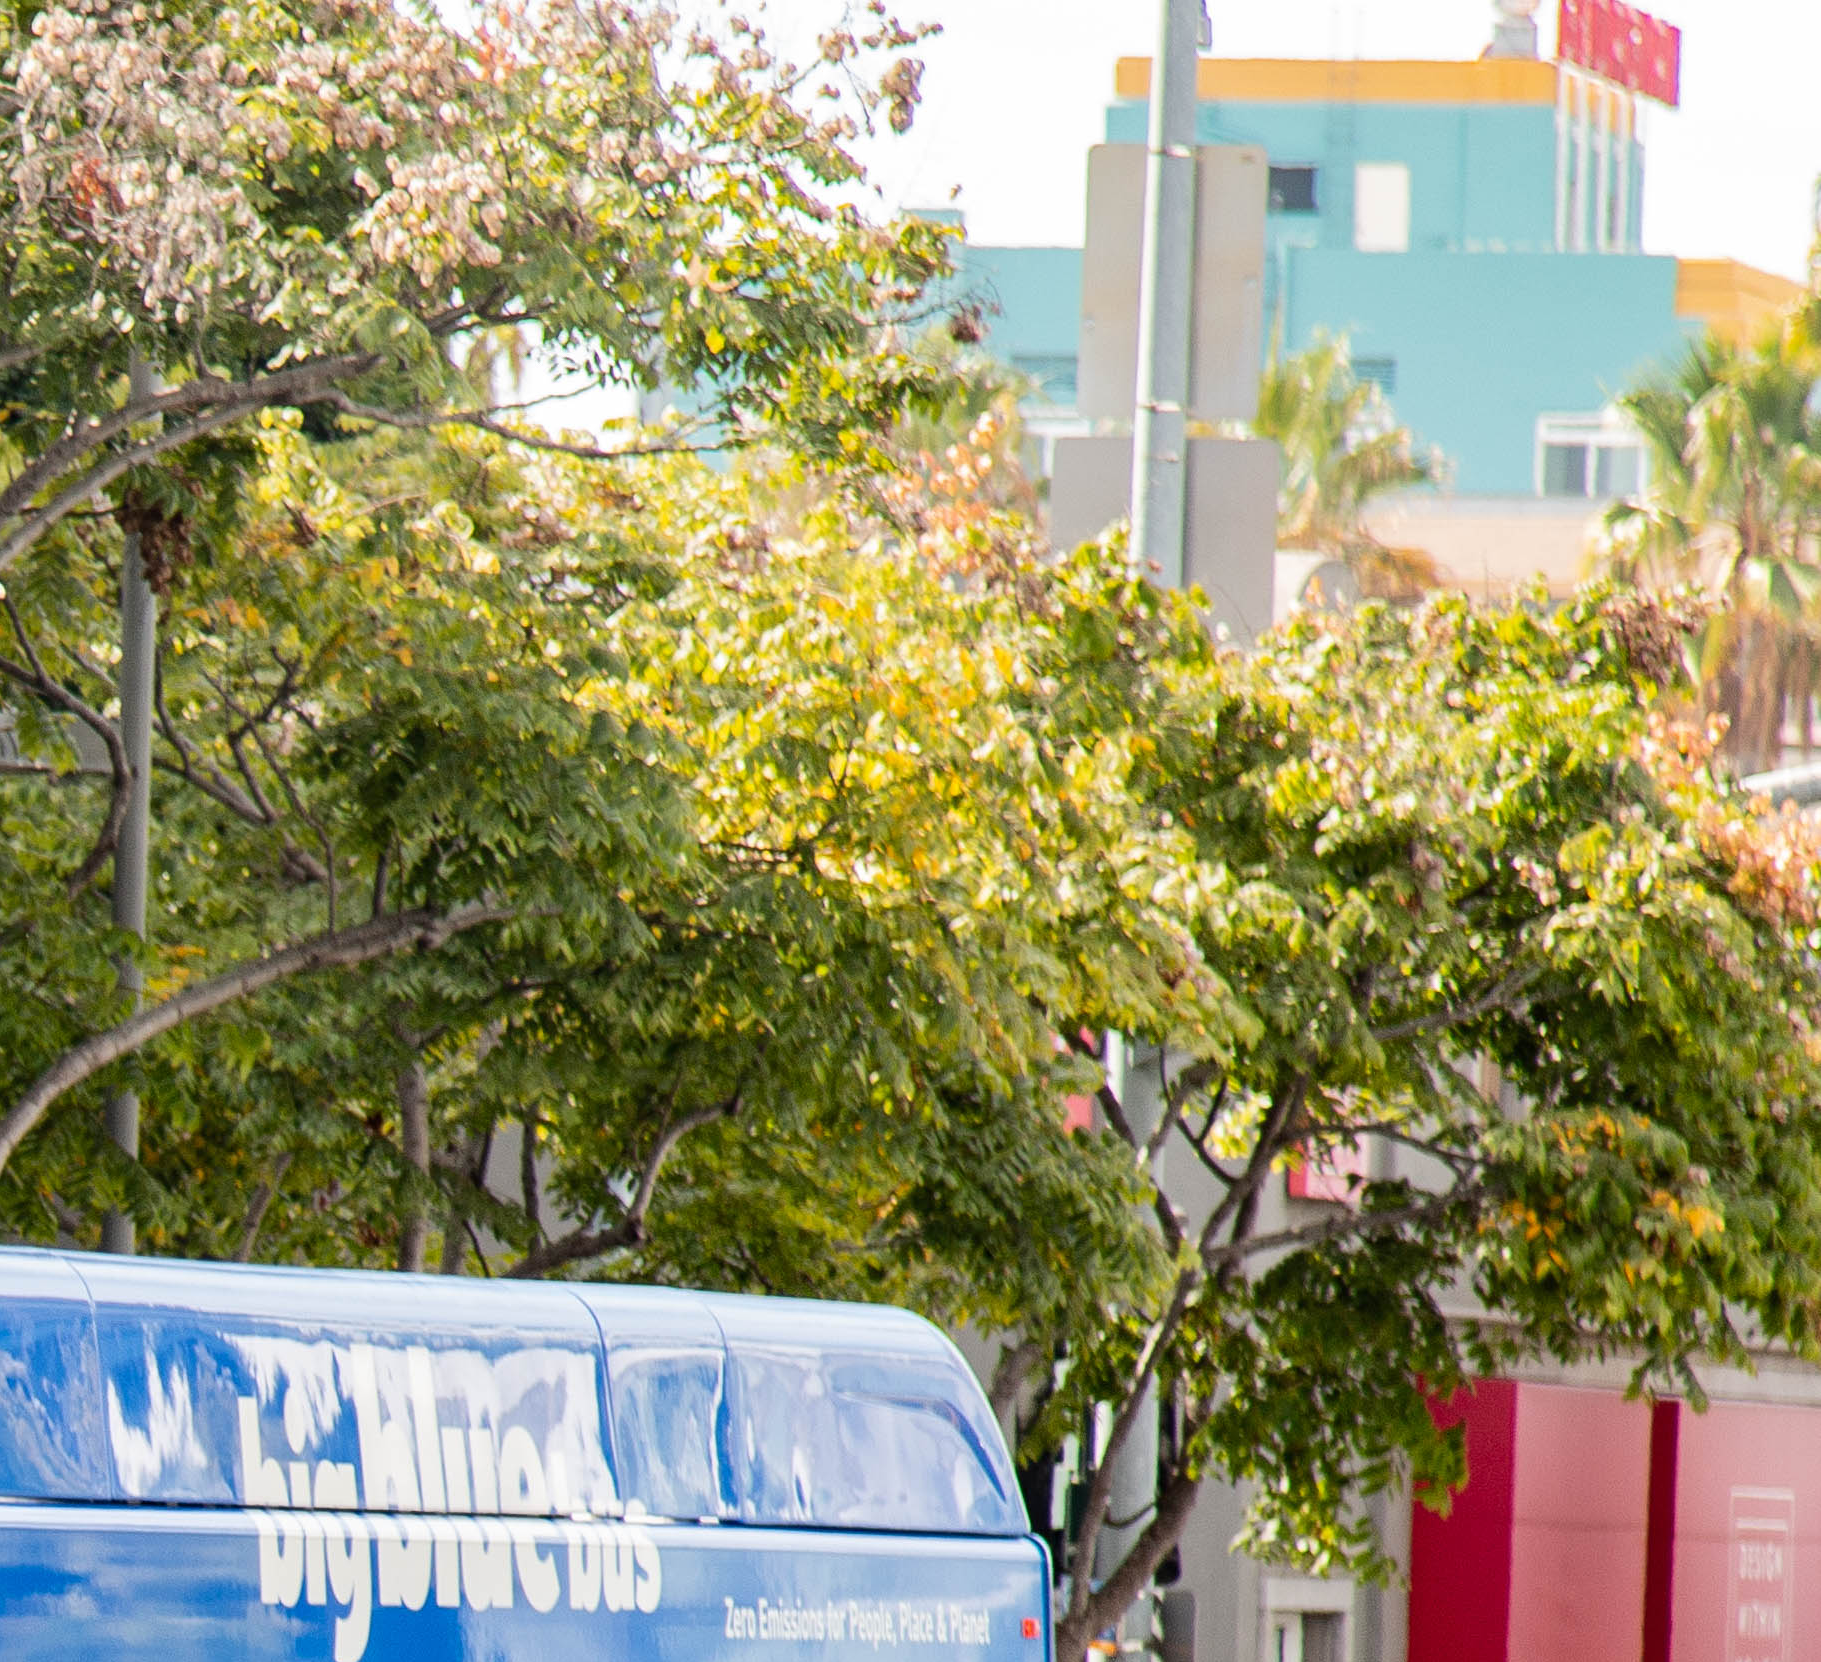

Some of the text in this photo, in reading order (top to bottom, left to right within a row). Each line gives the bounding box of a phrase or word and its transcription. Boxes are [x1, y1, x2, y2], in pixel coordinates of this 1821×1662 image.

[350, 1343, 560, 1613] blue
[549, 1450, 661, 1614] bus
[1738, 1540, 1783, 1582] DESIGN
[725, 1595, 991, 1650] Zero Emissions for People, Place & Planet
